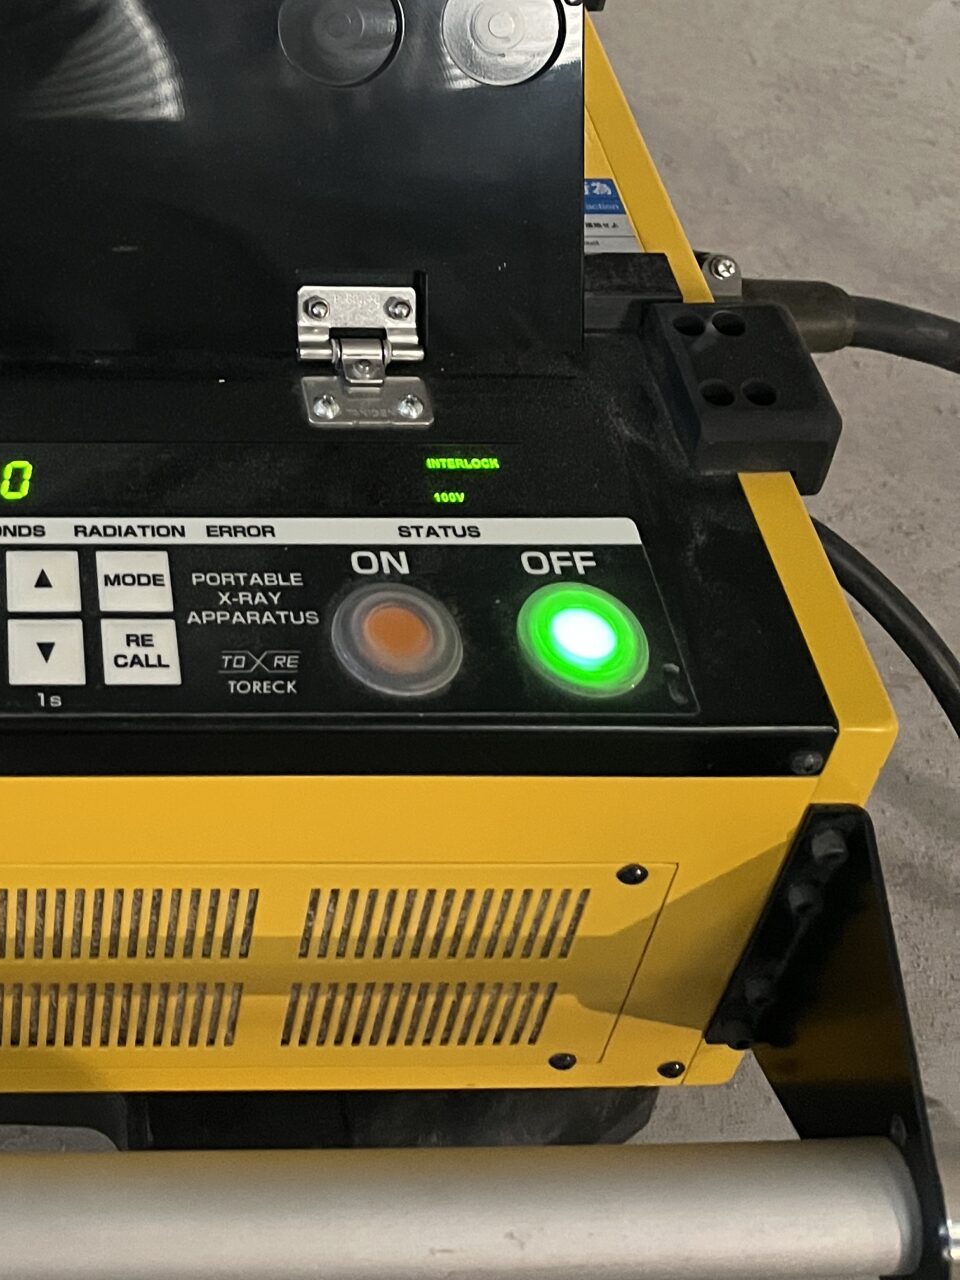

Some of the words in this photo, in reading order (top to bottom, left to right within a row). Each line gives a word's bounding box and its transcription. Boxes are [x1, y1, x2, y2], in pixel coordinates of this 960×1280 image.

[426, 458, 500, 469] INTERLOCK
[434, 492, 464, 503] 100V
[73, 524, 185, 538] RADIATION
[206, 525, 276, 538] ERROR
[397, 525, 481, 538] STATUS
[350, 550, 410, 575] ON
[520, 550, 596, 575] OFF
[104, 573, 165, 587] MODE
[191, 572, 304, 586] PORTABLE
[217, 591, 282, 606] X-RAY
[186, 610, 320, 625] APPARATUS
[125, 634, 154, 647] RE
[113, 653, 170, 668] CALL
[228, 680, 297, 694] TORECK
[37, 693, 62, 708] 1s
